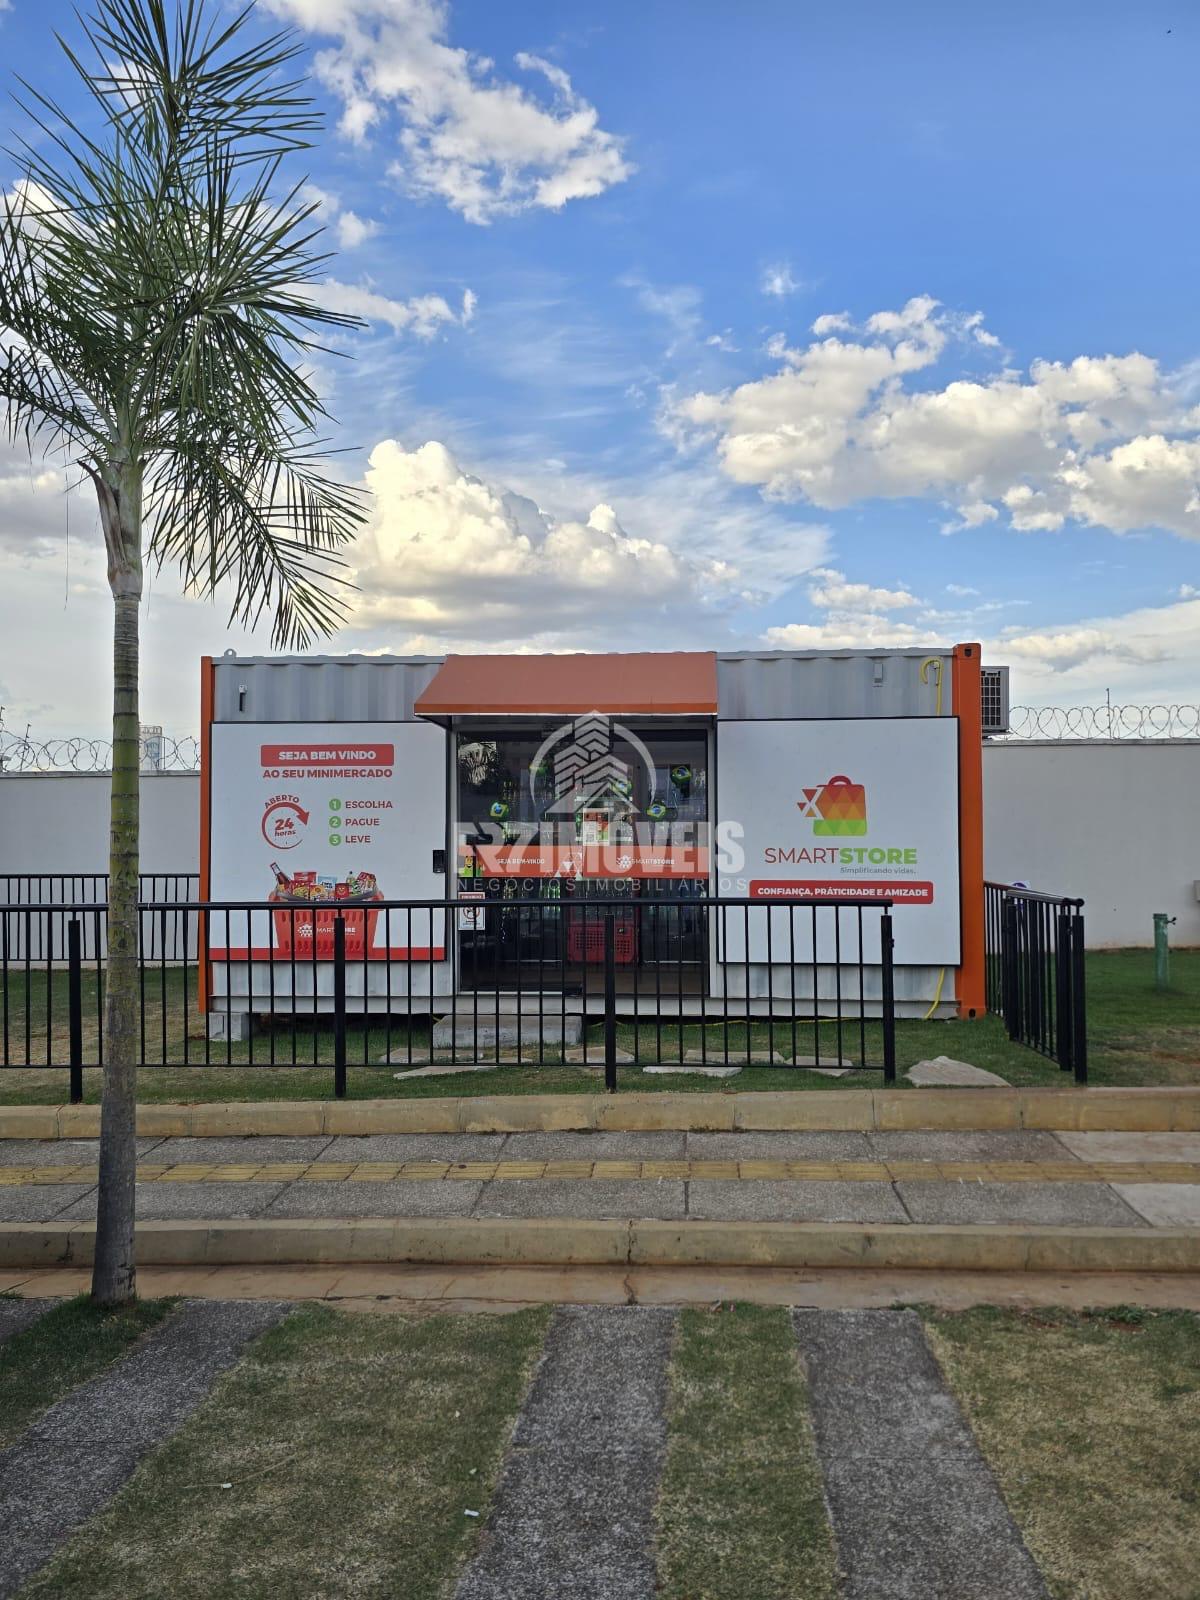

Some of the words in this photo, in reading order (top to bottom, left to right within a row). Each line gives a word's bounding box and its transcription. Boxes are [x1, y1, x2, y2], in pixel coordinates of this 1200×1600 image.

[278, 751, 308, 760] SEJA
[310, 751, 336, 760] BEM
[338, 750, 376, 760] VINDO
[262, 769, 280, 778] AO
[282, 769, 305, 778] SEU
[307, 769, 393, 778] MINIMERCADO
[264, 794, 300, 809] ABERTO
[345, 800, 393, 809] ESCOLHA
[274, 817, 295, 830] 24
[345, 818, 380, 826] PAGUE
[274, 828, 297, 838] horas
[345, 835, 371, 843] LEVE
[840, 866, 892, 875] Simplificando
[757, 887, 813, 897] CONFIANÇA,
[814, 886, 876, 896] PRÁTICIDADE
[877, 888, 883, 896] E
[884, 888, 928, 897] AMIZADE
